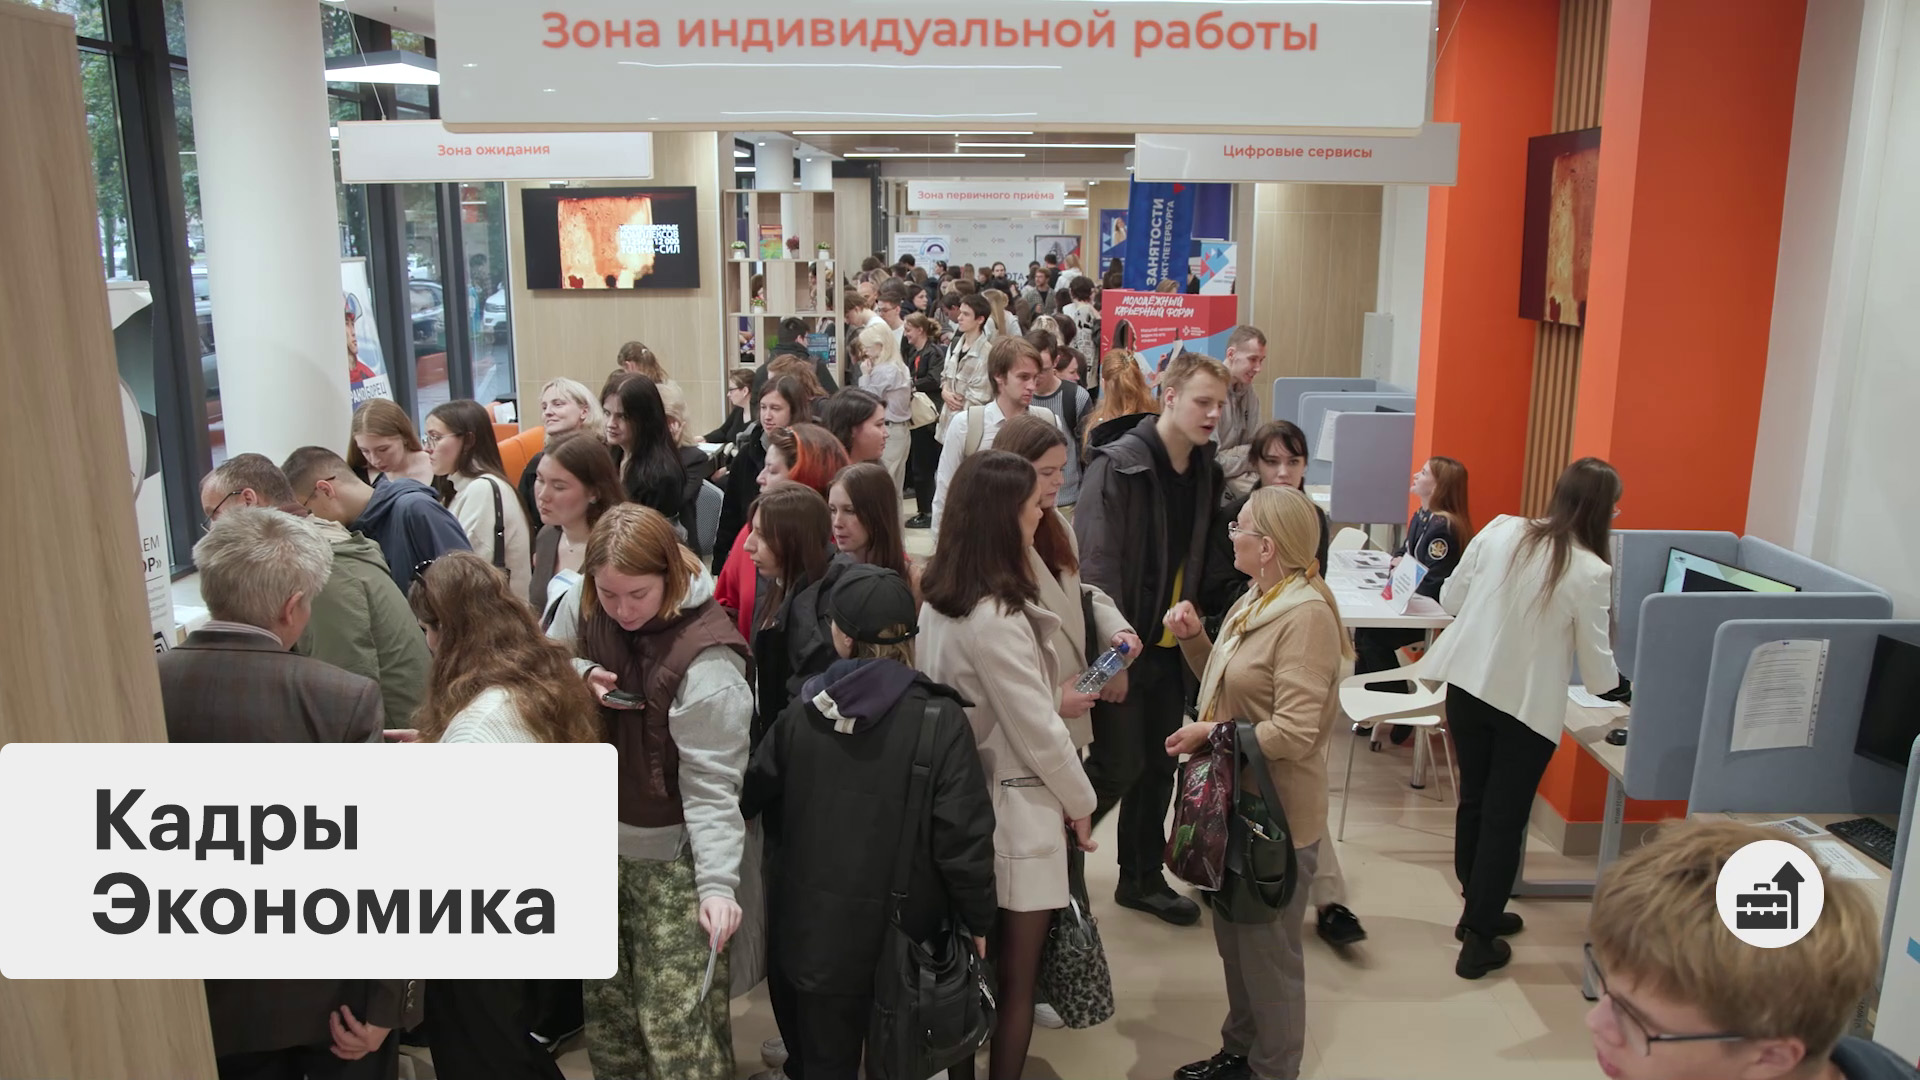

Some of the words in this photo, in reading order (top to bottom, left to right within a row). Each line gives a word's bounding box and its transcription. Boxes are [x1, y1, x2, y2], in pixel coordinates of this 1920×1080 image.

[541, 11, 660, 49] Зона
[677, 9, 1117, 57] индивидуальной
[1134, 9, 1319, 58] работы
[437, 143, 472, 157] Зона
[476, 143, 551, 158] ожидания
[1223, 144, 1304, 160] Цифровые
[1308, 146, 1373, 160] сервисы
[918, 191, 944, 200] Зона
[947, 192, 1011, 201] первичного
[1013, 190, 1055, 201] приёма
[621, 244, 681, 254] ТОННА-СИЛ
[1146, 198, 1165, 286] ЗАНЯТОСТИ
[1114, 305, 1164, 318] КАРЬЕРНЫЙ
[1165, 307, 1195, 318] ФОРУМ
